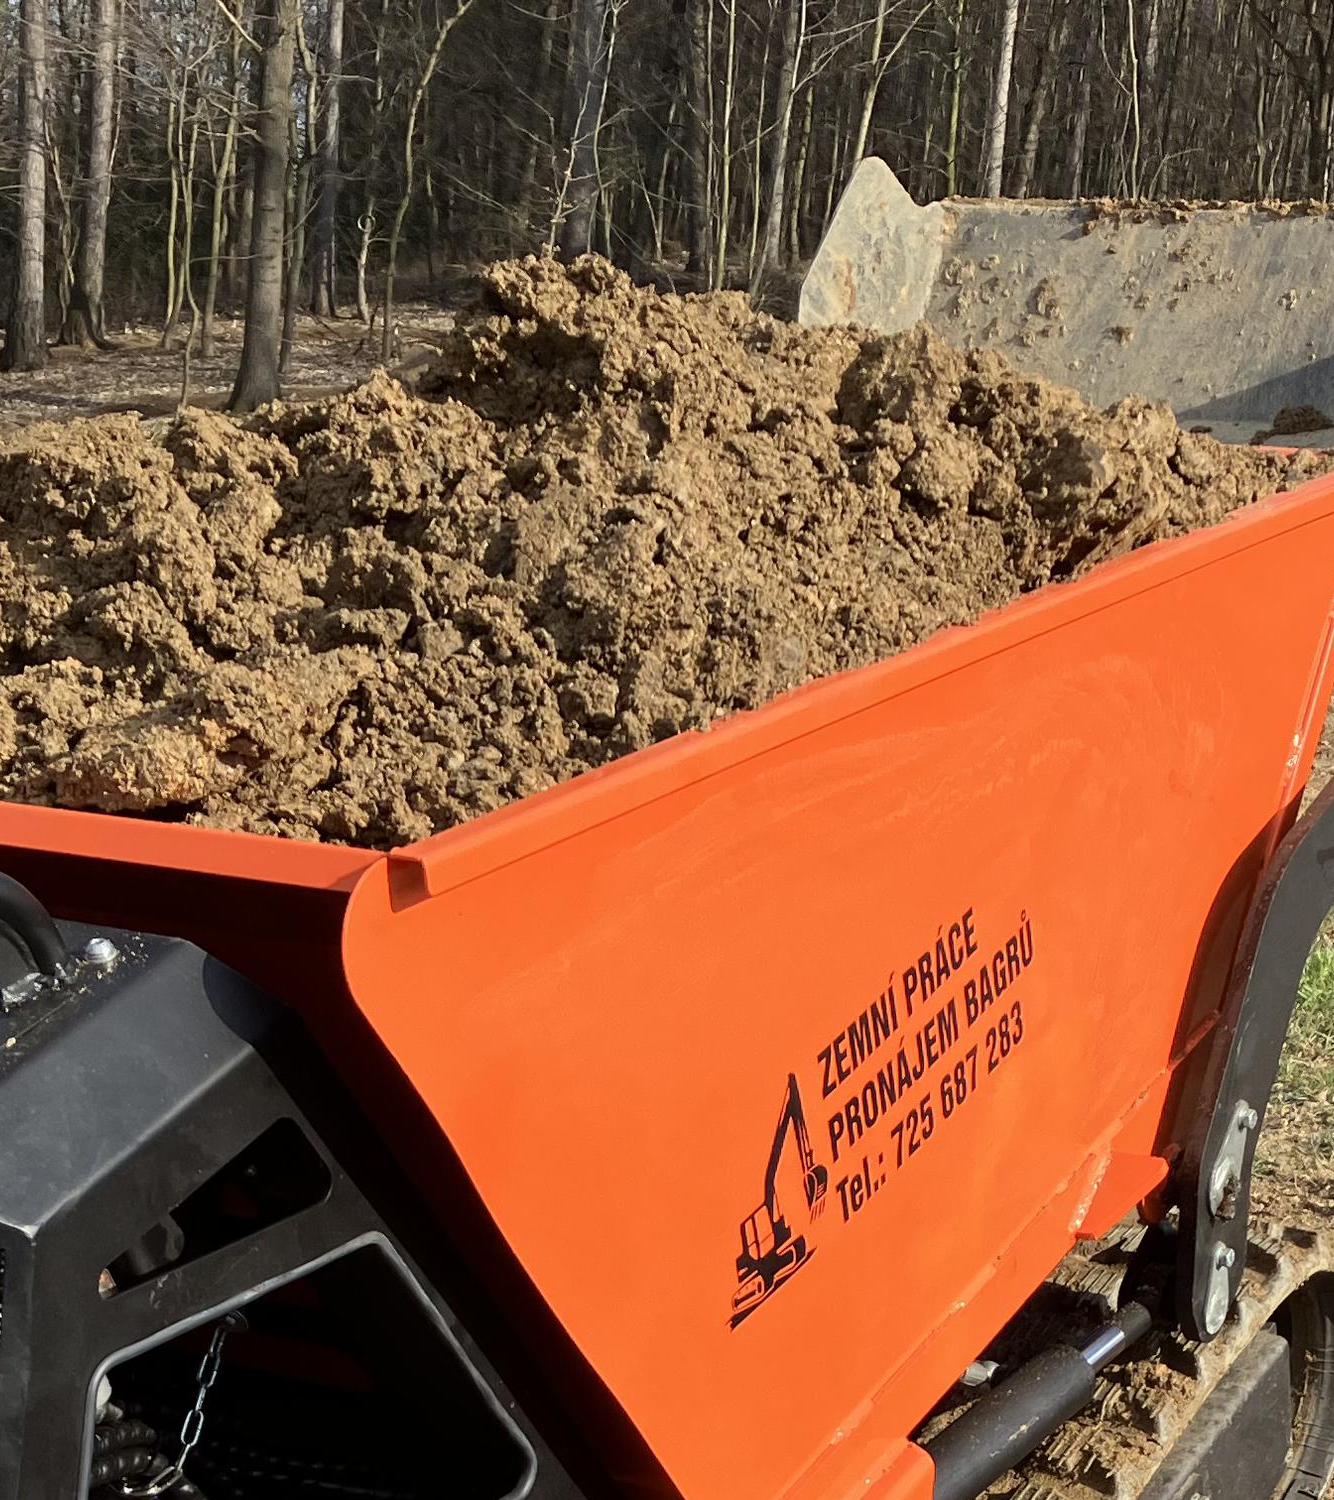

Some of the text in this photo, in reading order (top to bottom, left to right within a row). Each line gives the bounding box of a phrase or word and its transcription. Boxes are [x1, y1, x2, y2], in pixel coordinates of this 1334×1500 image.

[817, 906, 979, 1100] ZEMNÍ PRÁCE
[828, 908, 1034, 1164] PRONÁJEM BAGRŮ
[835, 1000, 1024, 1225] Tel.: 725 687 283
